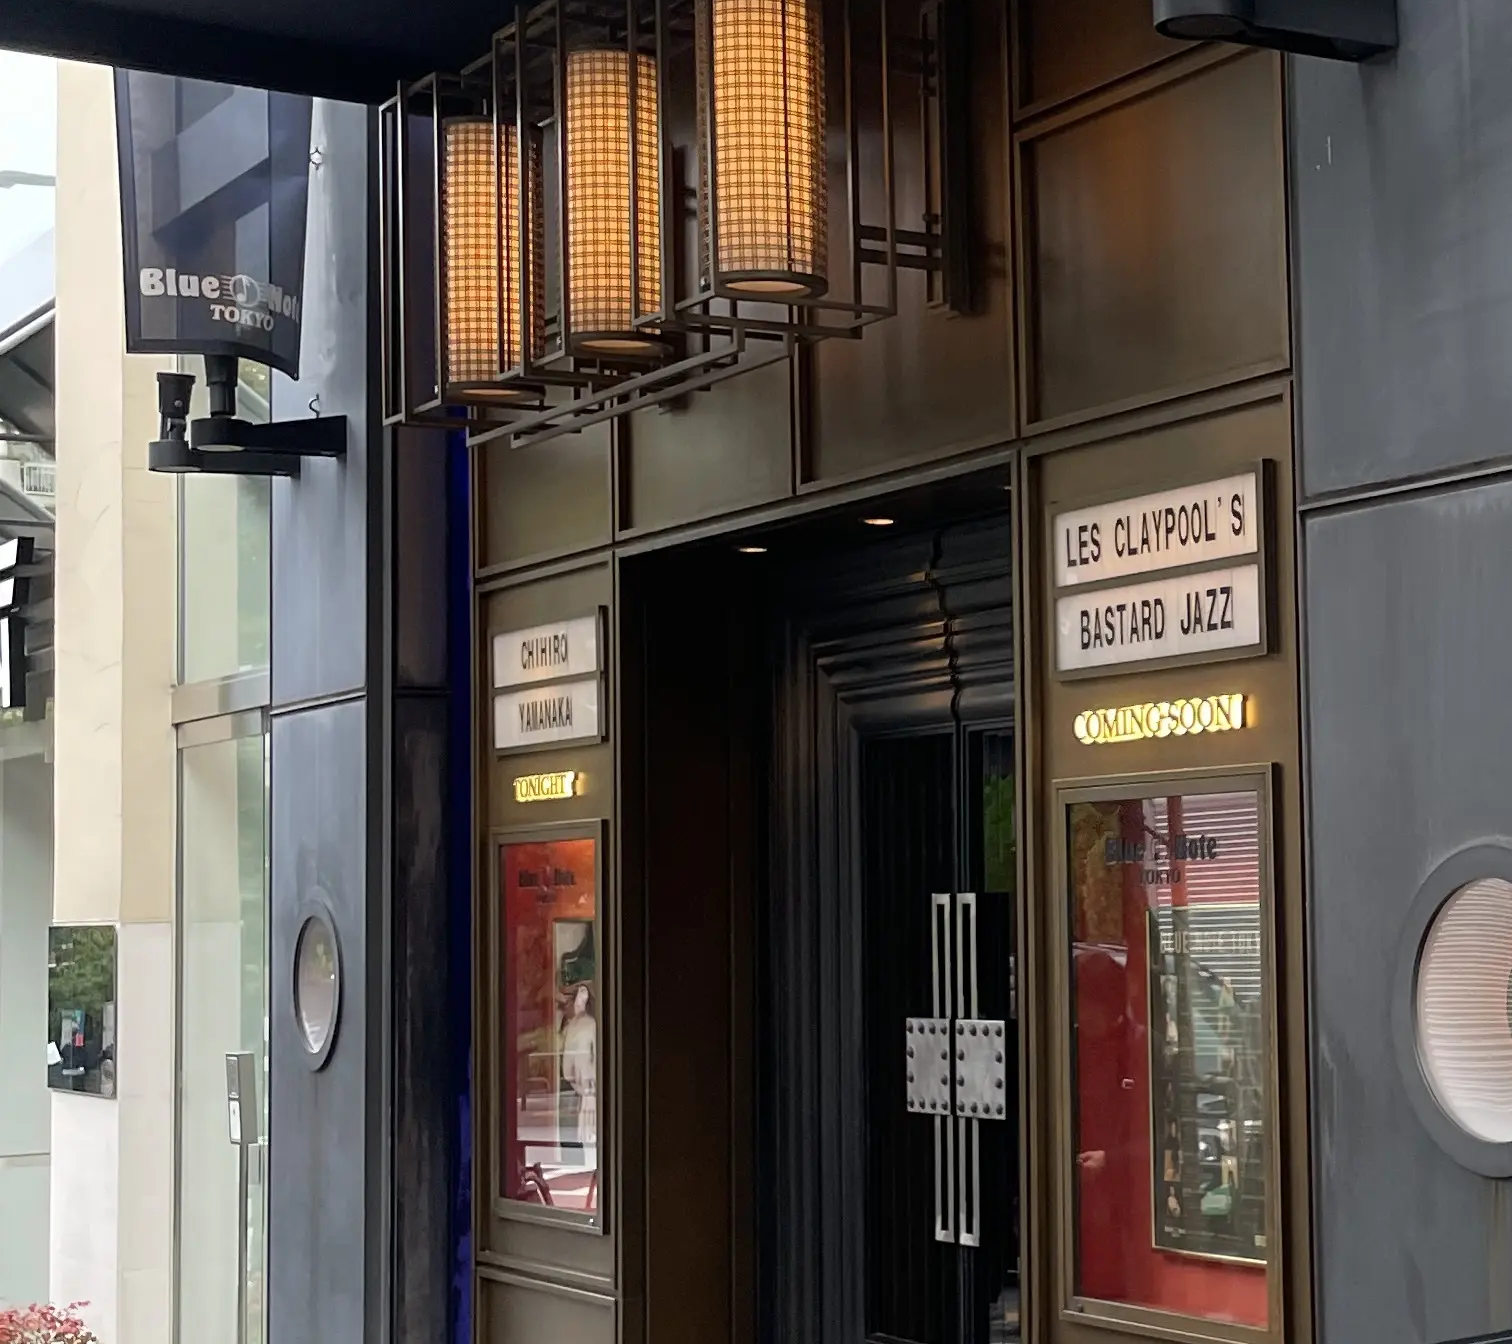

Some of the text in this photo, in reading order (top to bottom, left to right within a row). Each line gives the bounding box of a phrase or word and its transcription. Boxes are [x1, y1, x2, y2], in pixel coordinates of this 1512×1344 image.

[139, 267, 220, 299] Blue
[210, 303, 275, 333] TOKYO
[1065, 493, 1245, 568] LES CLAYPOOL'S
[1080, 585, 1233, 650] BASTARD JAZZ
[521, 632, 569, 670] CHIHIRO
[519, 696, 573, 733] YAMANAKA
